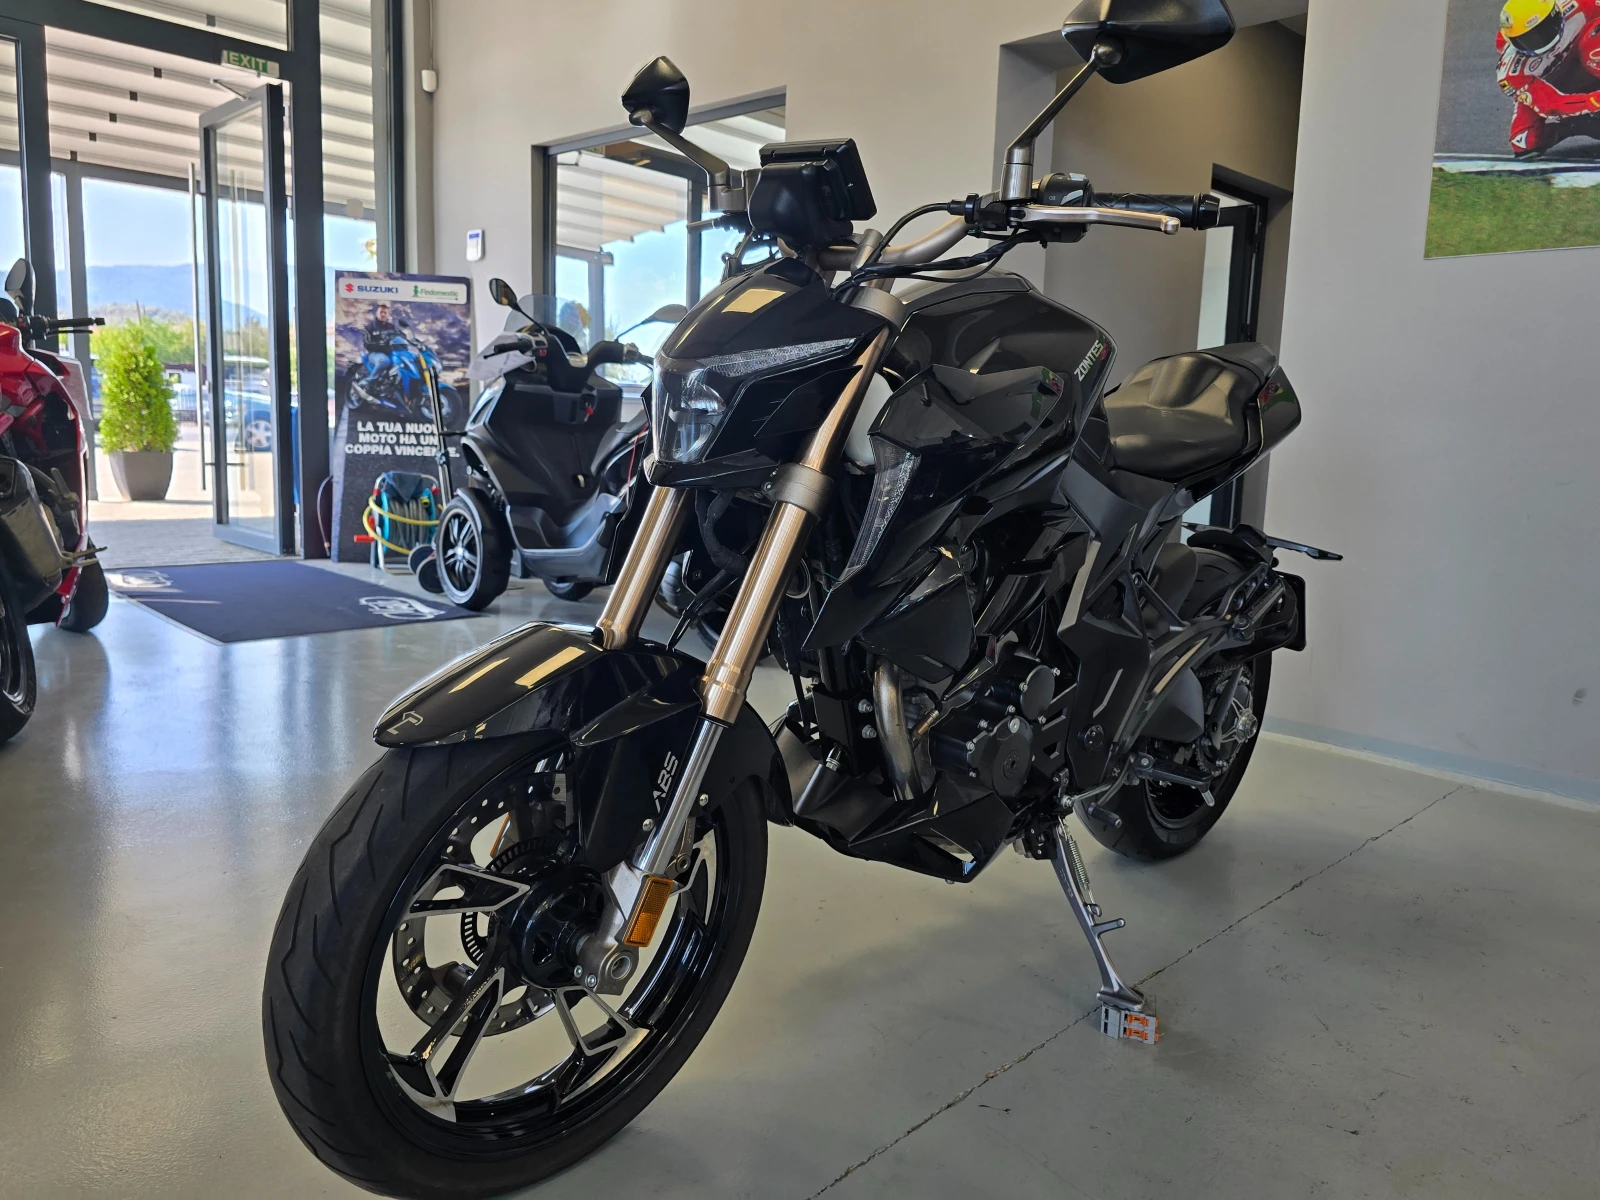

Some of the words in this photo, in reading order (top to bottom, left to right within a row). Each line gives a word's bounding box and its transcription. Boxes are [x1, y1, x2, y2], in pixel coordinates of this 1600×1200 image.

[229, 51, 266, 72] EXIT
[357, 285, 399, 294] SUZUKI
[1073, 339, 1104, 382] ZONTES
[357, 421, 374, 432] LA
[376, 422, 403, 433] TUA
[358, 433, 397, 444] MOTO
[399, 433, 418, 445] HA
[344, 444, 392, 455] COPPIA
[653, 751, 678, 813] ABS
